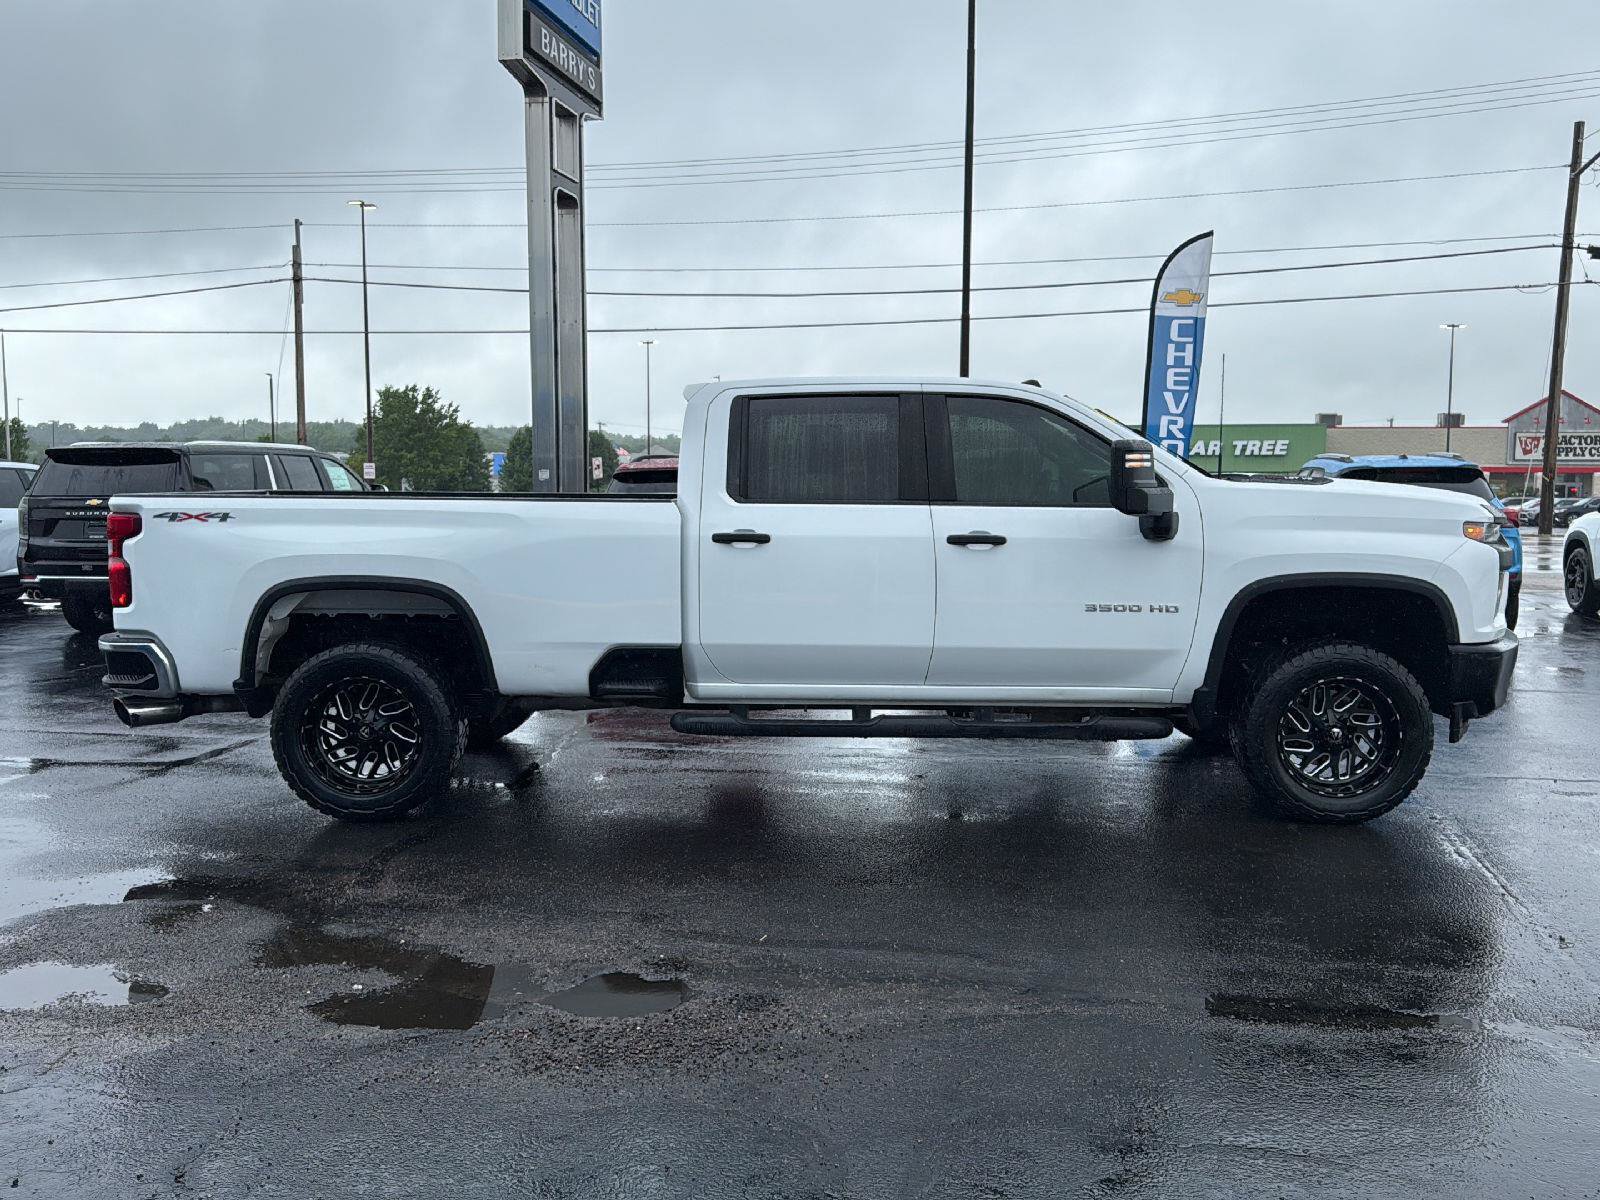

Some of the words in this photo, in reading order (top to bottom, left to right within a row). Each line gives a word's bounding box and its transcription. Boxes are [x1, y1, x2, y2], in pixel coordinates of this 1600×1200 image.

[541, 27, 596, 90] BARRY'S
[1542, 435, 1600, 445] ACTOR
[1232, 440, 1290, 456] TREE
[1084, 603, 1143, 613] 3500
[1149, 604, 1180, 614] HD
